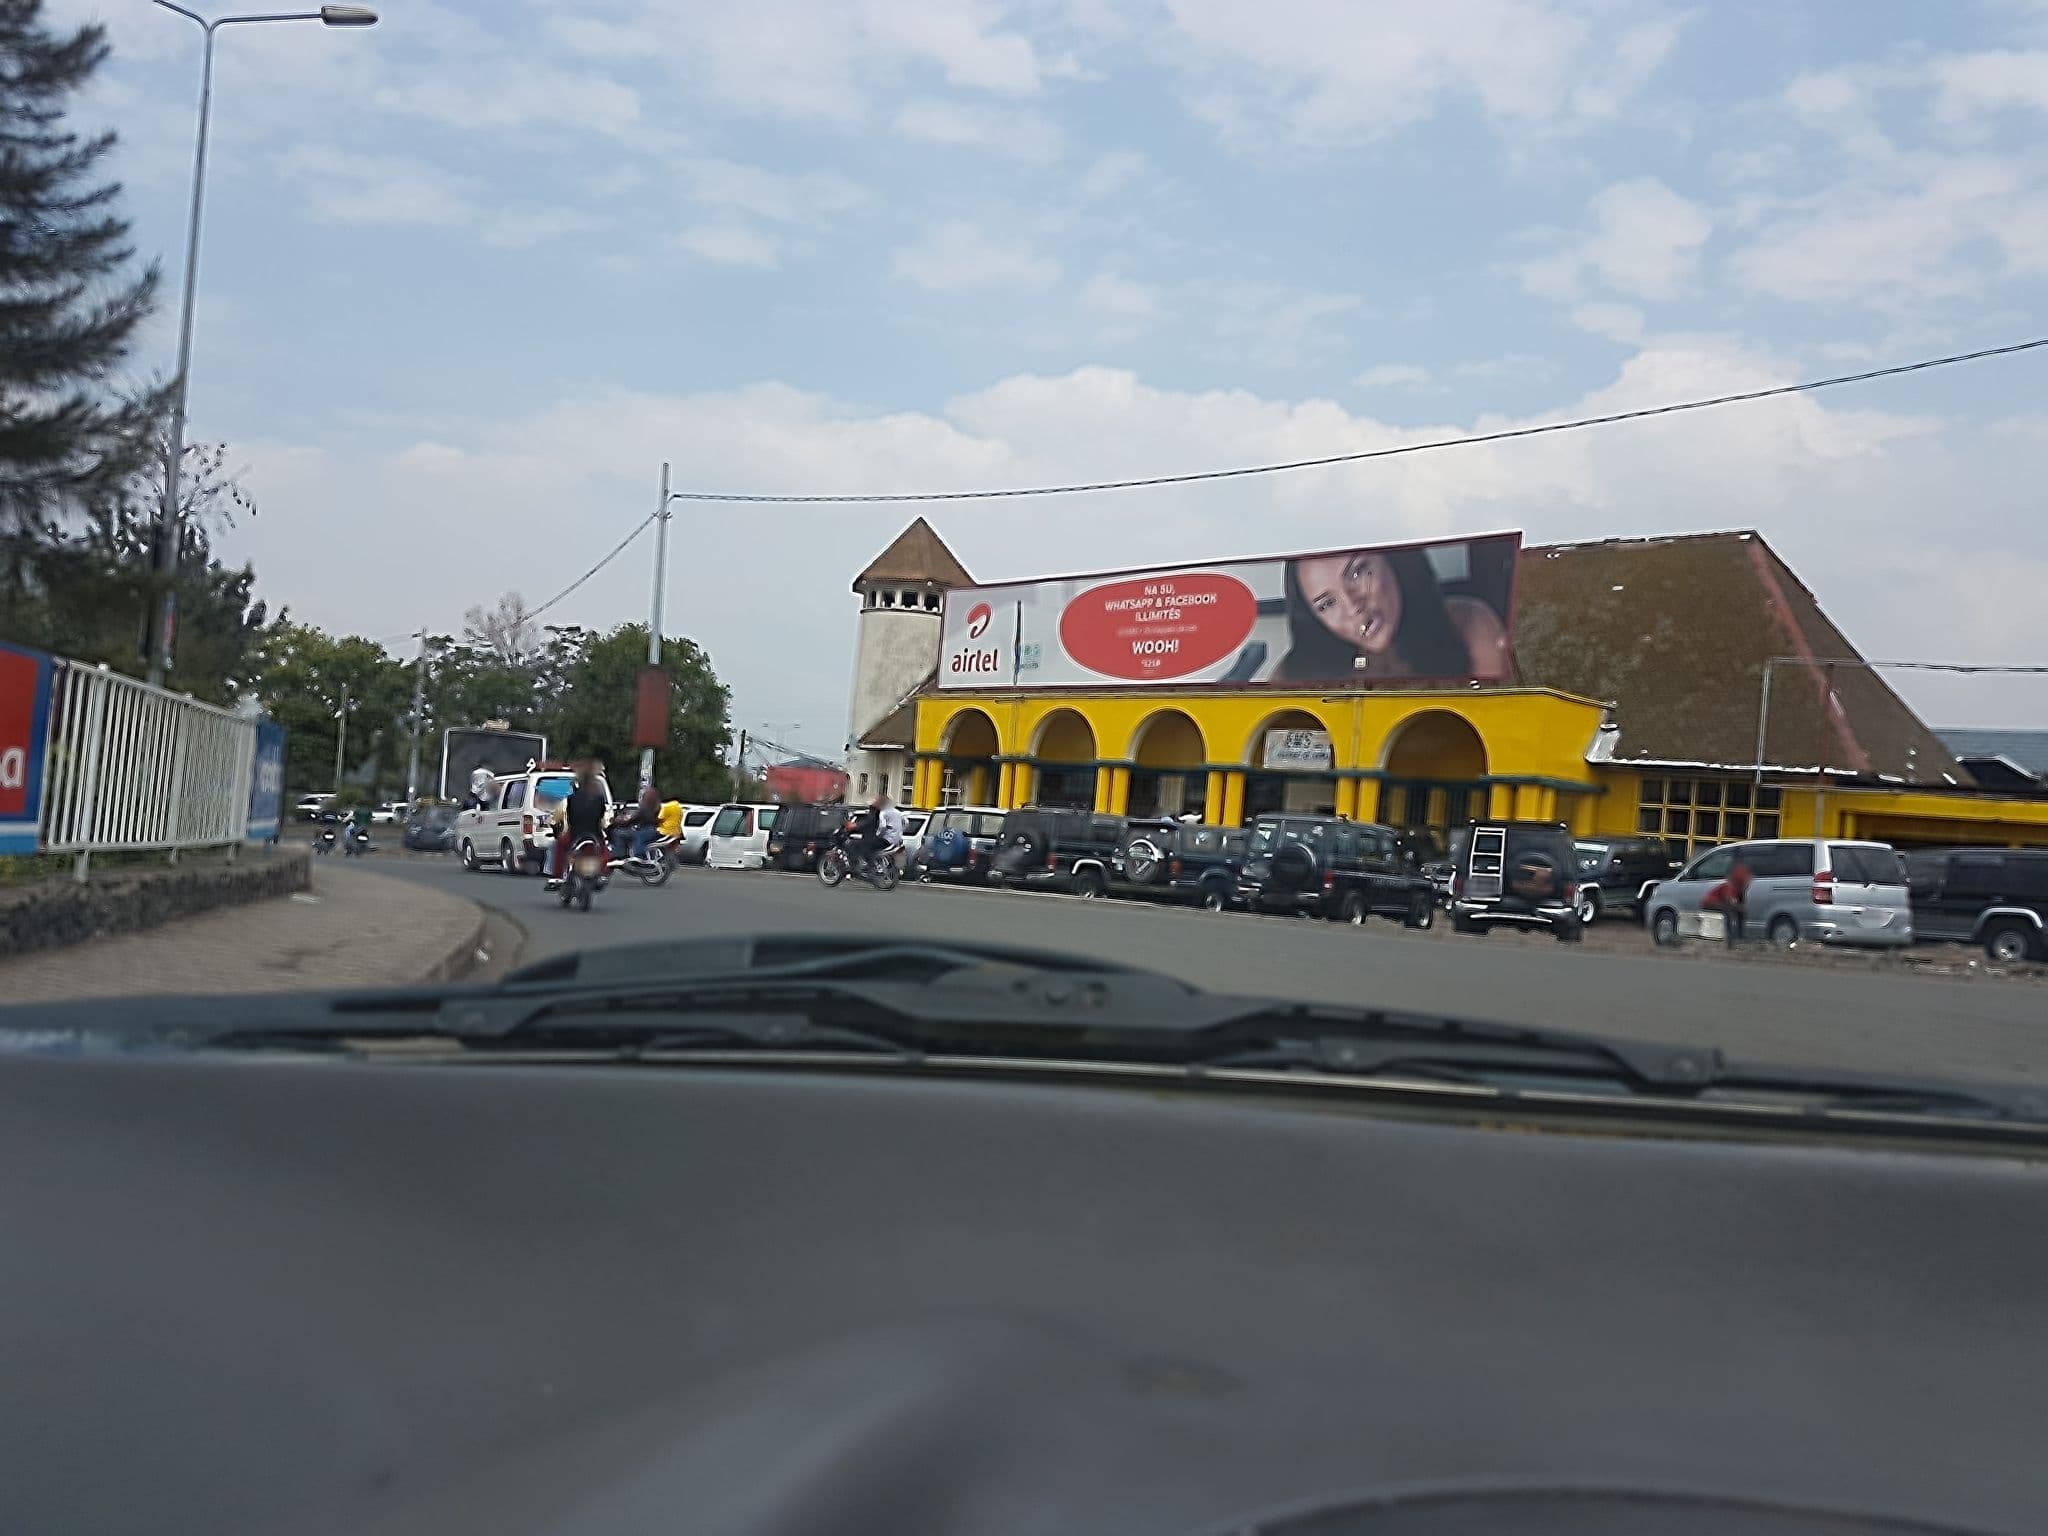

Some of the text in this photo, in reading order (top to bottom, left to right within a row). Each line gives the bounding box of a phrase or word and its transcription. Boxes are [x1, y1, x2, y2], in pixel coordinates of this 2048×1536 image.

[1144, 585, 1157, 595] NA
[1105, 593, 1217, 611] WHATSAPP & FACEBOOK
[1135, 608, 1181, 621] ILLIMITÉS
[1132, 639, 1179, 655] WOOH!
[951, 647, 998, 673] airtel
